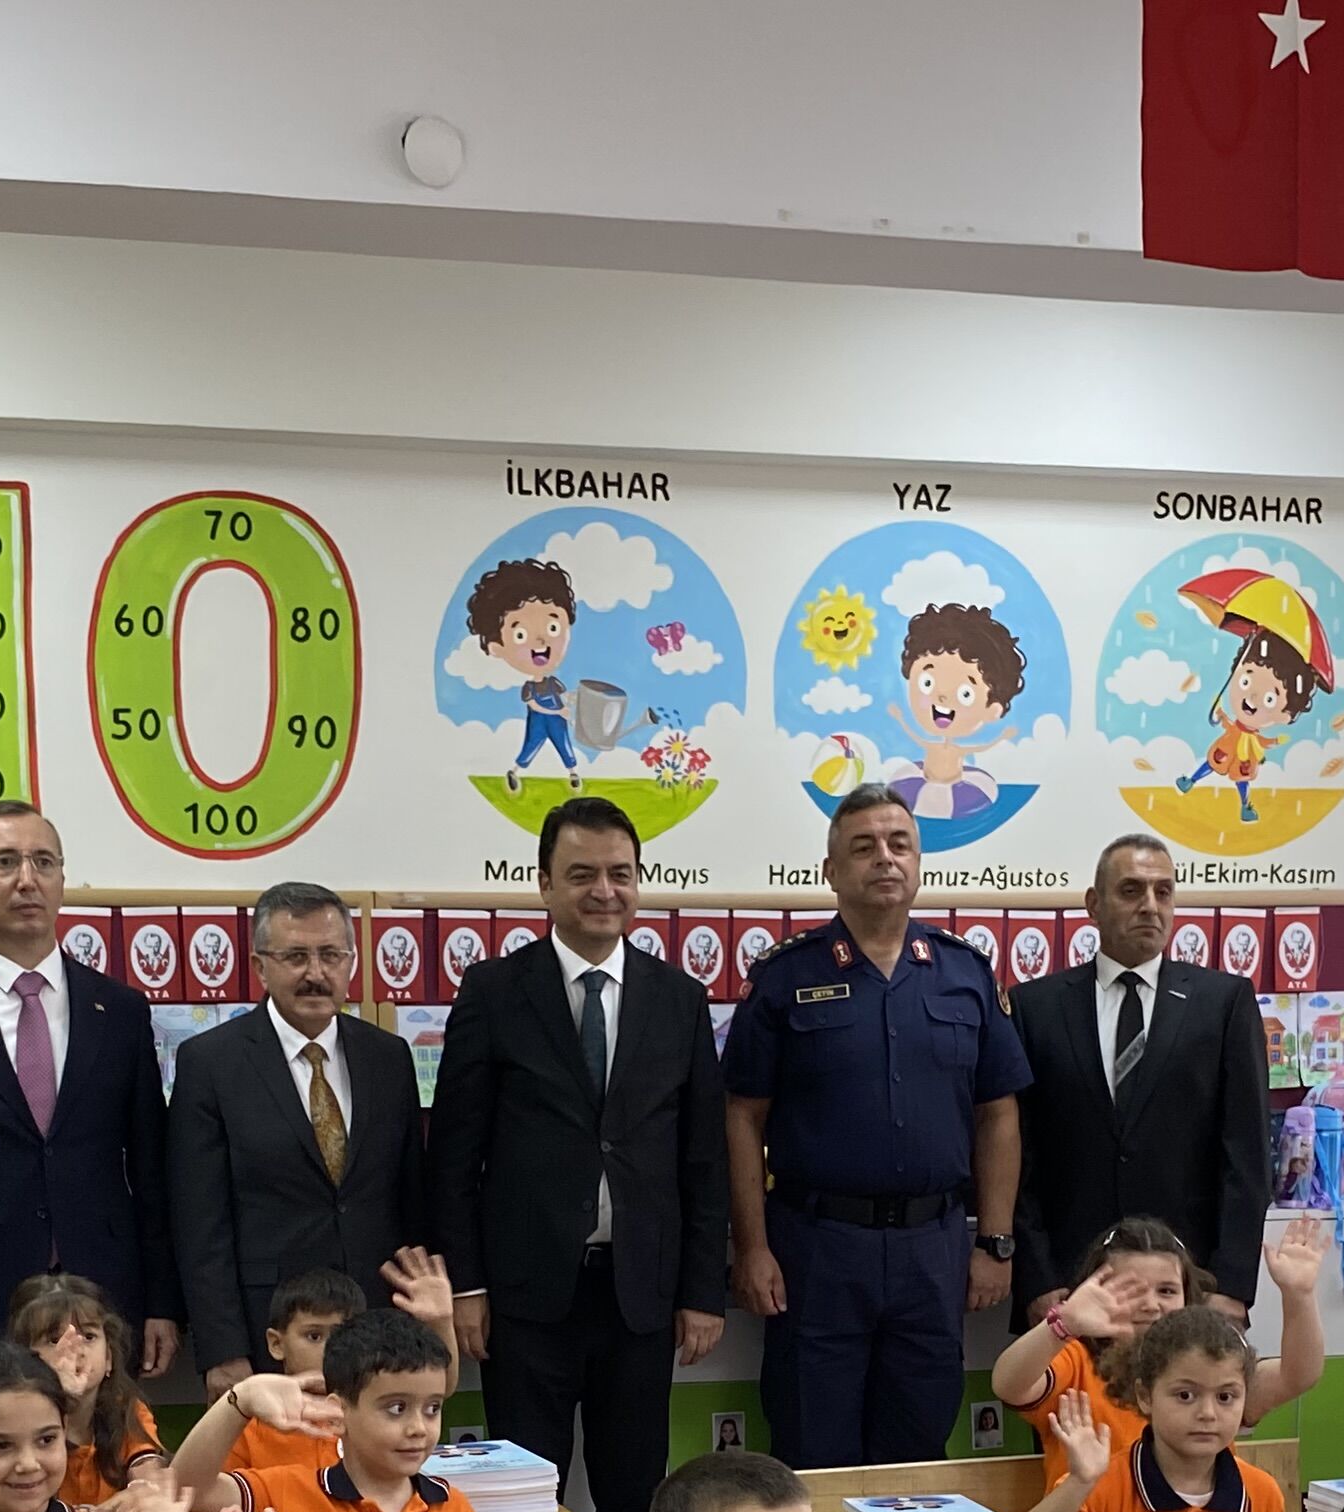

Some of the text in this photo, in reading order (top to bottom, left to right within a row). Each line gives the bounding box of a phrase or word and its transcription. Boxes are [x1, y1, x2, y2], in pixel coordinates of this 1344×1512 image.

[504, 459, 671, 503] İLKBAHAR
[891, 481, 953, 513] YAZ
[1152, 490, 1324, 526] SONBAHAR
[204, 510, 254, 542] 70
[114, 603, 165, 638] 60
[290, 606, 341, 643] 80
[111, 708, 162, 741] 50
[286, 713, 338, 750] 90
[183, 802, 259, 837] 100
[1173, 862, 1336, 886] ül-Ekim-Kasım
[201, 990, 227, 999] ATA
[387, 991, 412, 999] ATA
[1287, 980, 1308, 989] ATA
